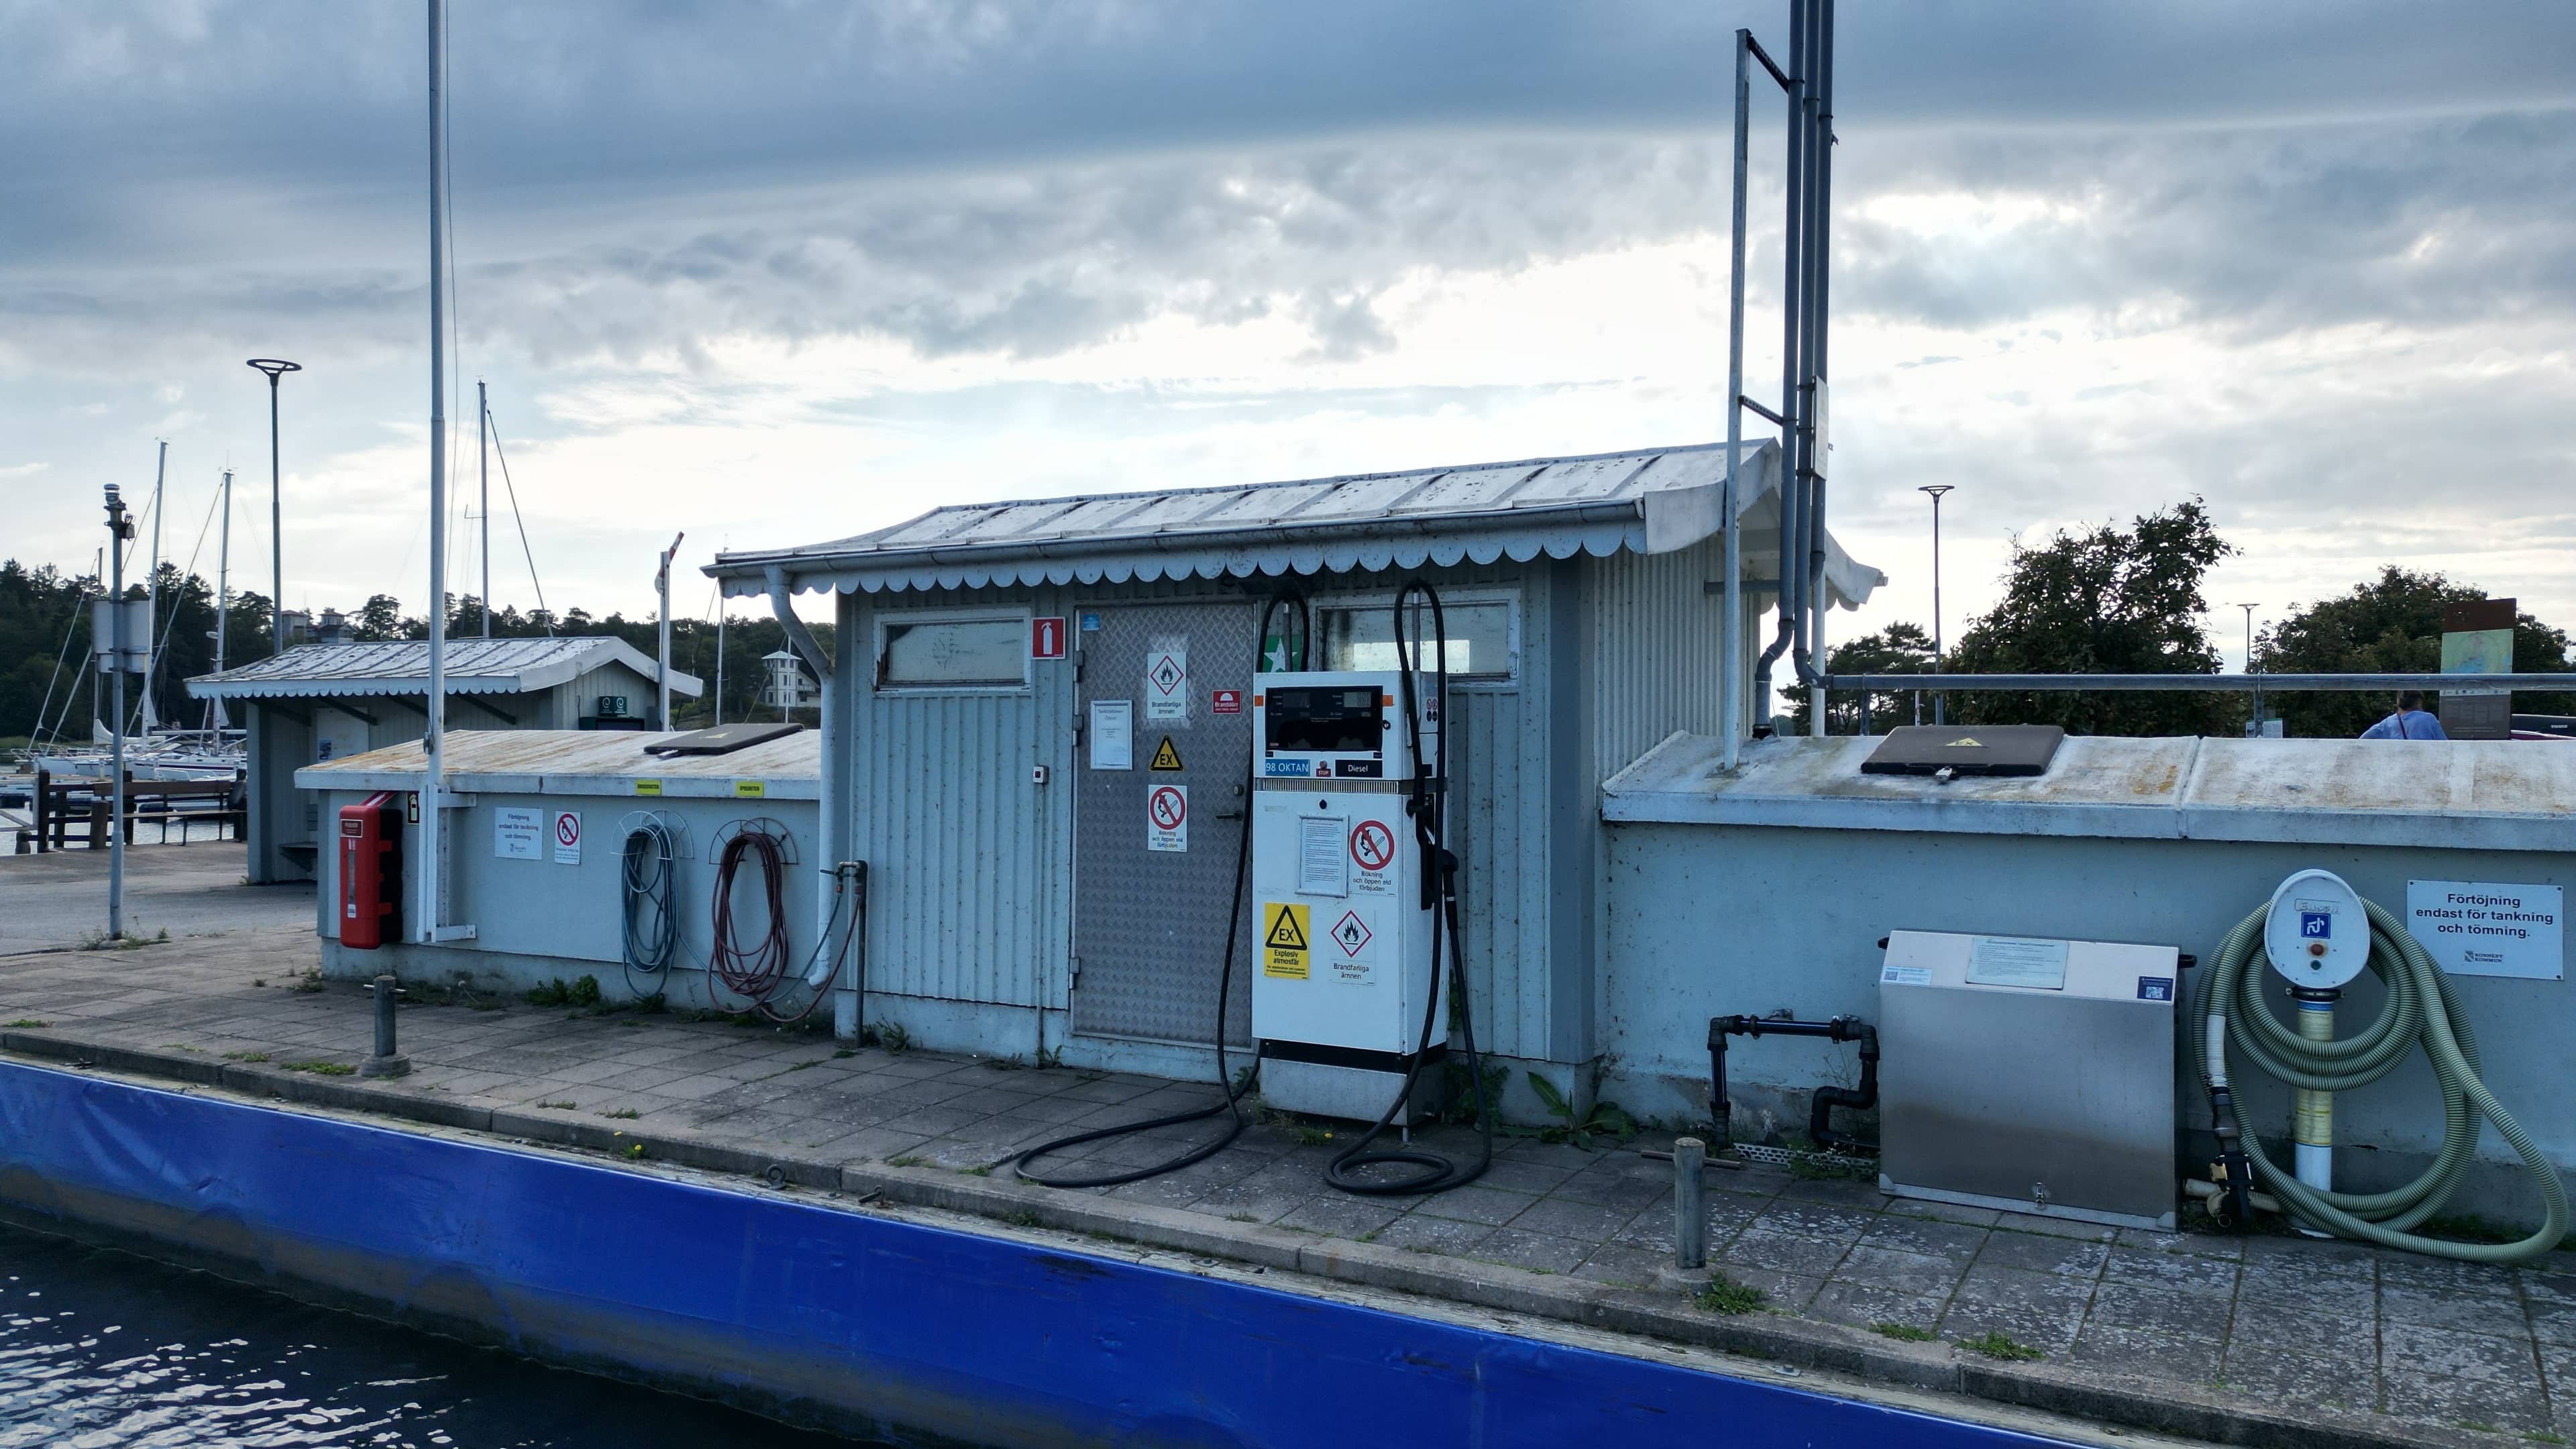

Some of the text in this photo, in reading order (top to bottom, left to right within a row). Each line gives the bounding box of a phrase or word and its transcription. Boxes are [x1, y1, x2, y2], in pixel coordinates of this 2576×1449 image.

[1160, 754, 1173, 765] EX
[1266, 763, 1309, 773] 98 OKTAN
[1348, 764, 1368, 772] Diesel
[1361, 871, 1383, 879] Rökning
[2447, 894, 2520, 908] Förtöjning
[2416, 908, 2553, 924] endast för tankning
[1279, 928, 1295, 942] EX
[2438, 924, 2531, 938] och tömning.
[1275, 949, 1299, 958] Explosiv
[1273, 957, 1299, 965] atmosfär
[1334, 963, 1369, 973] Brandfarliga
